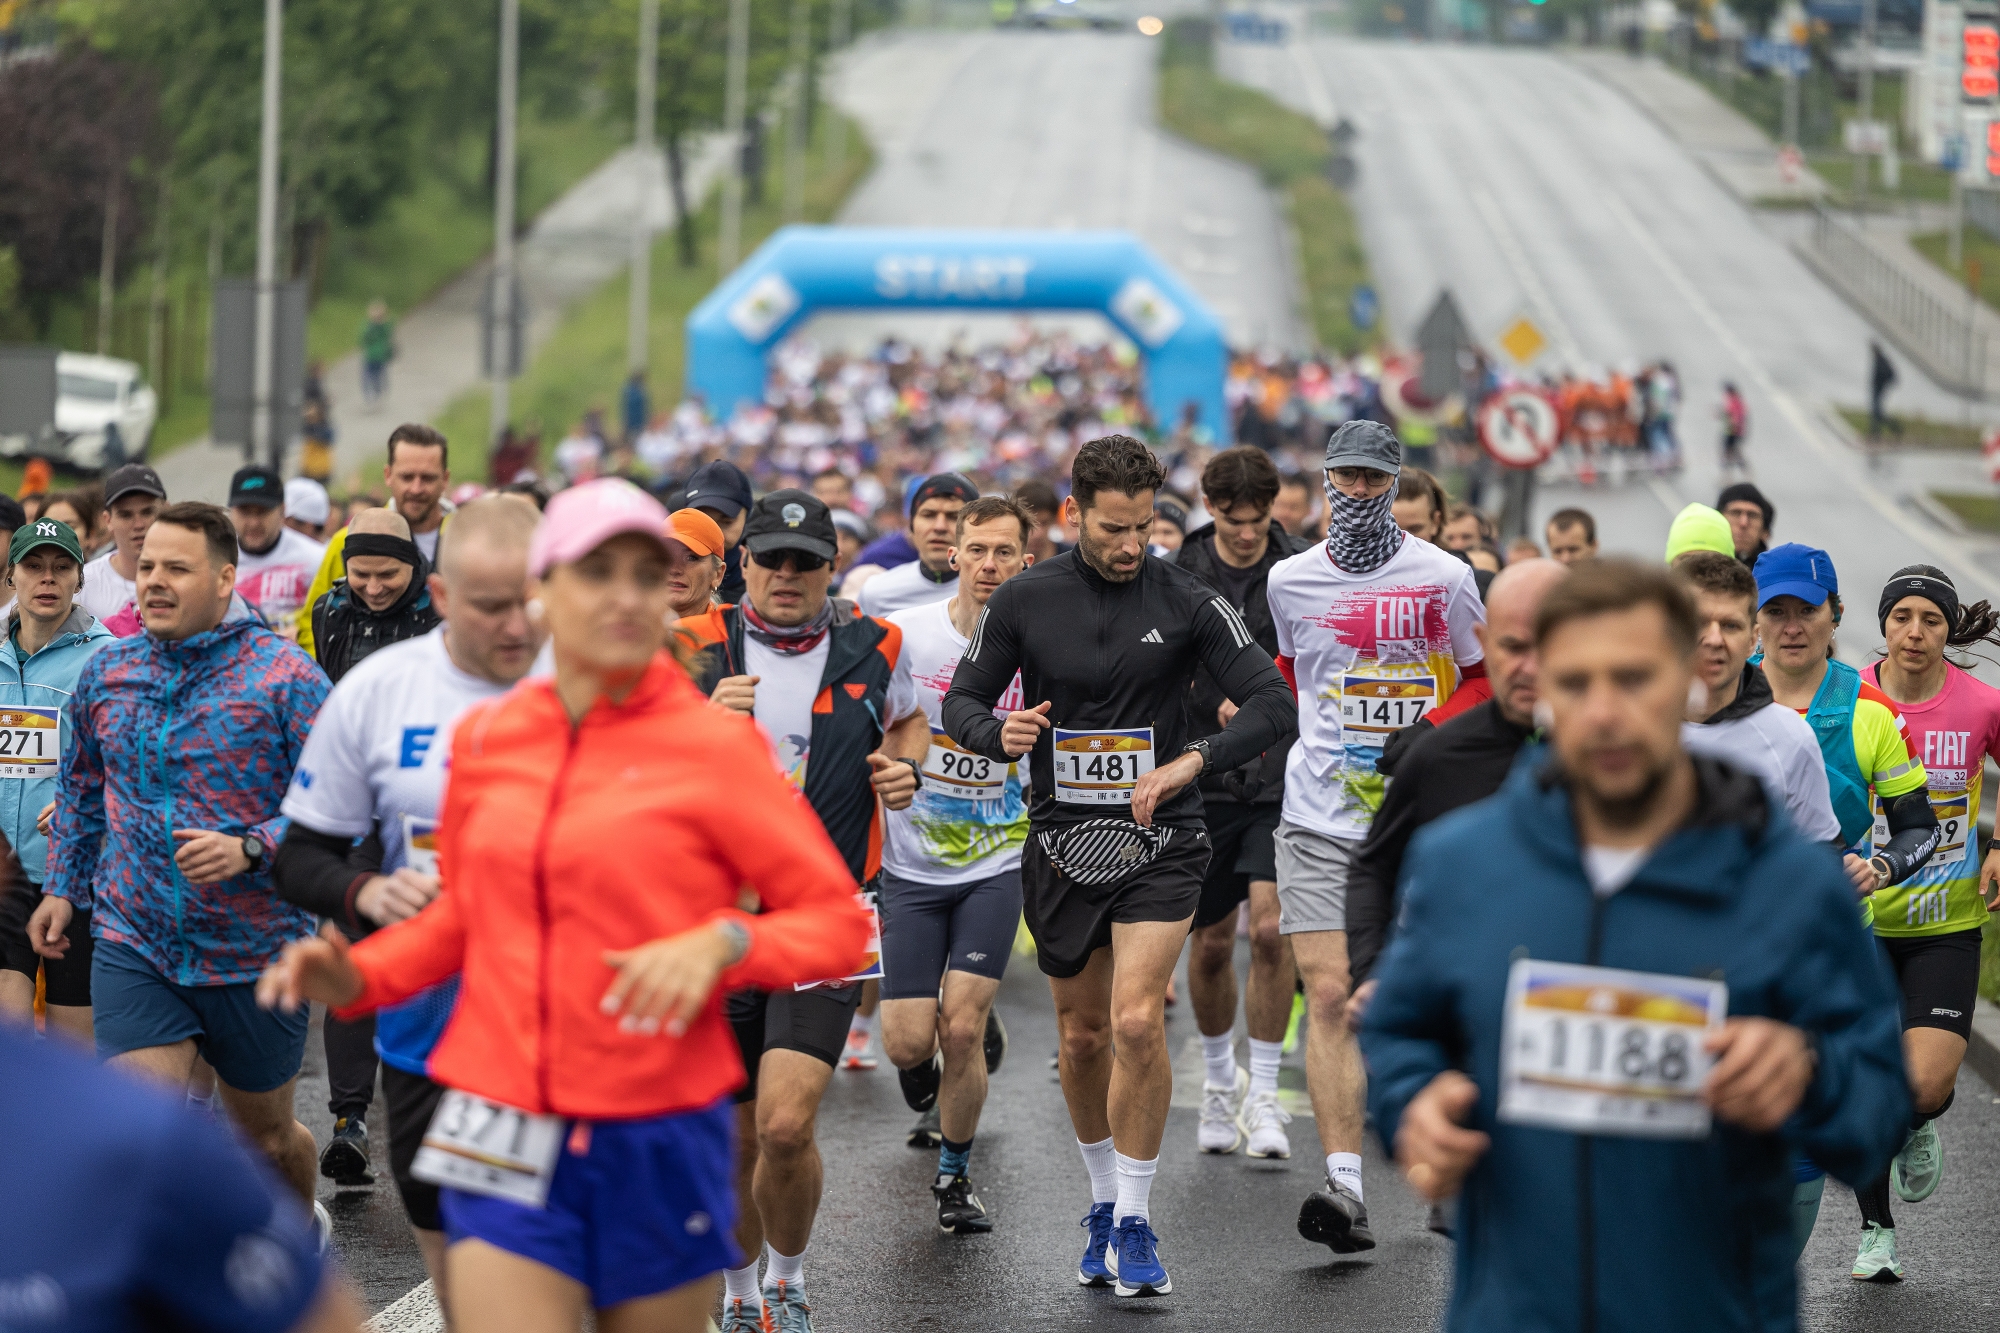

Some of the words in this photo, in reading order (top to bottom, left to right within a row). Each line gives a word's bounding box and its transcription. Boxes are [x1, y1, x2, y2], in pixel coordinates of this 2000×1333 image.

[875, 256, 1032, 299] START
[36, 522, 57, 536] NY
[1376, 597, 1430, 638] FIAT
[1412, 641, 1427, 651] 32
[1359, 700, 1426, 724] 1417
[1924, 731, 1970, 765] FIAT
[942, 752, 990, 780] 903
[1070, 754, 1138, 781] 1481
[1954, 772, 1965, 781] 32
[1907, 889, 1950, 924] FIAT
[967, 951, 987, 962] 4F
[1551, 1019, 1689, 1082] 1188
